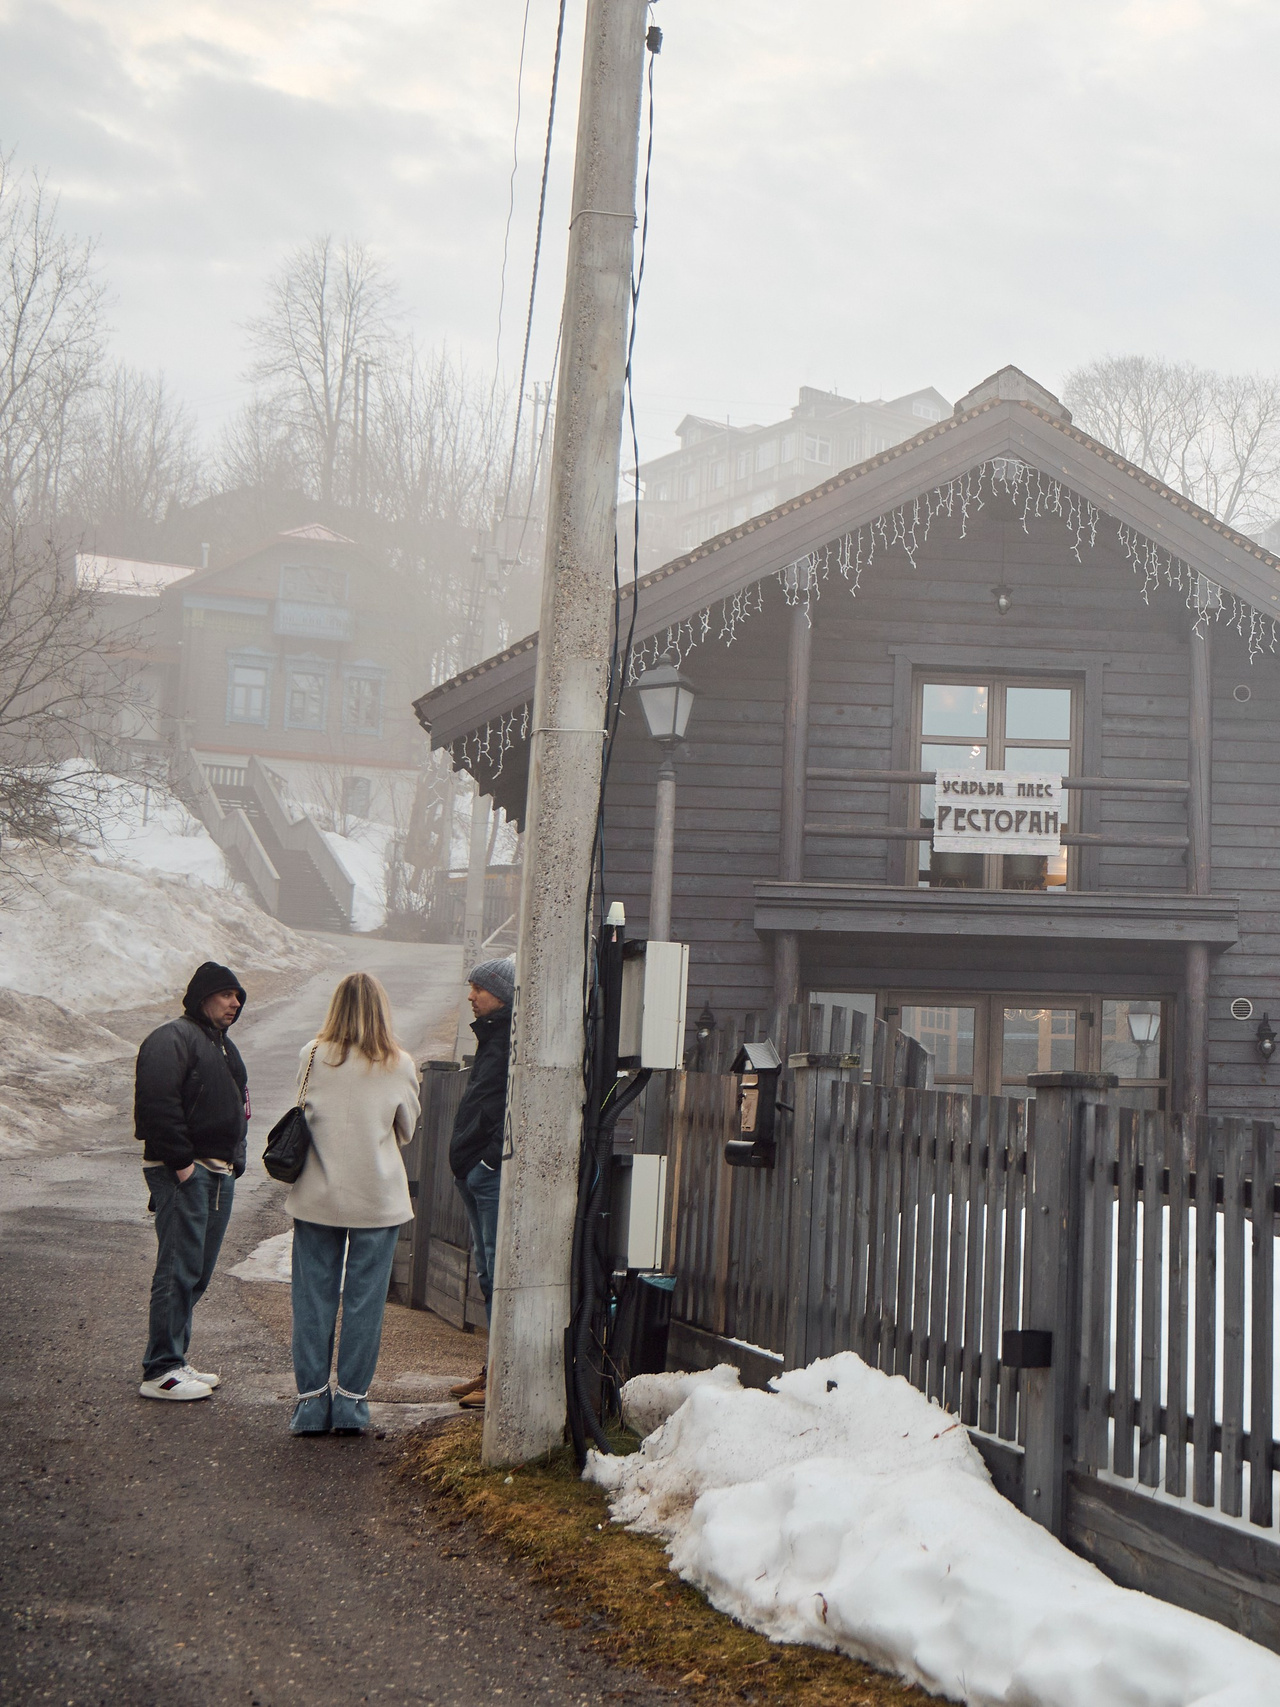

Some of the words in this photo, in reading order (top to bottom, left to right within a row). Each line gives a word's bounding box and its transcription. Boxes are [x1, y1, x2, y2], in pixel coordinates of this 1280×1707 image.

[942, 780, 1004, 796] УСАДЬБА
[1017, 783, 1053, 797] ПЛЕС
[937, 805, 1059, 834] РЕСТОРАН
